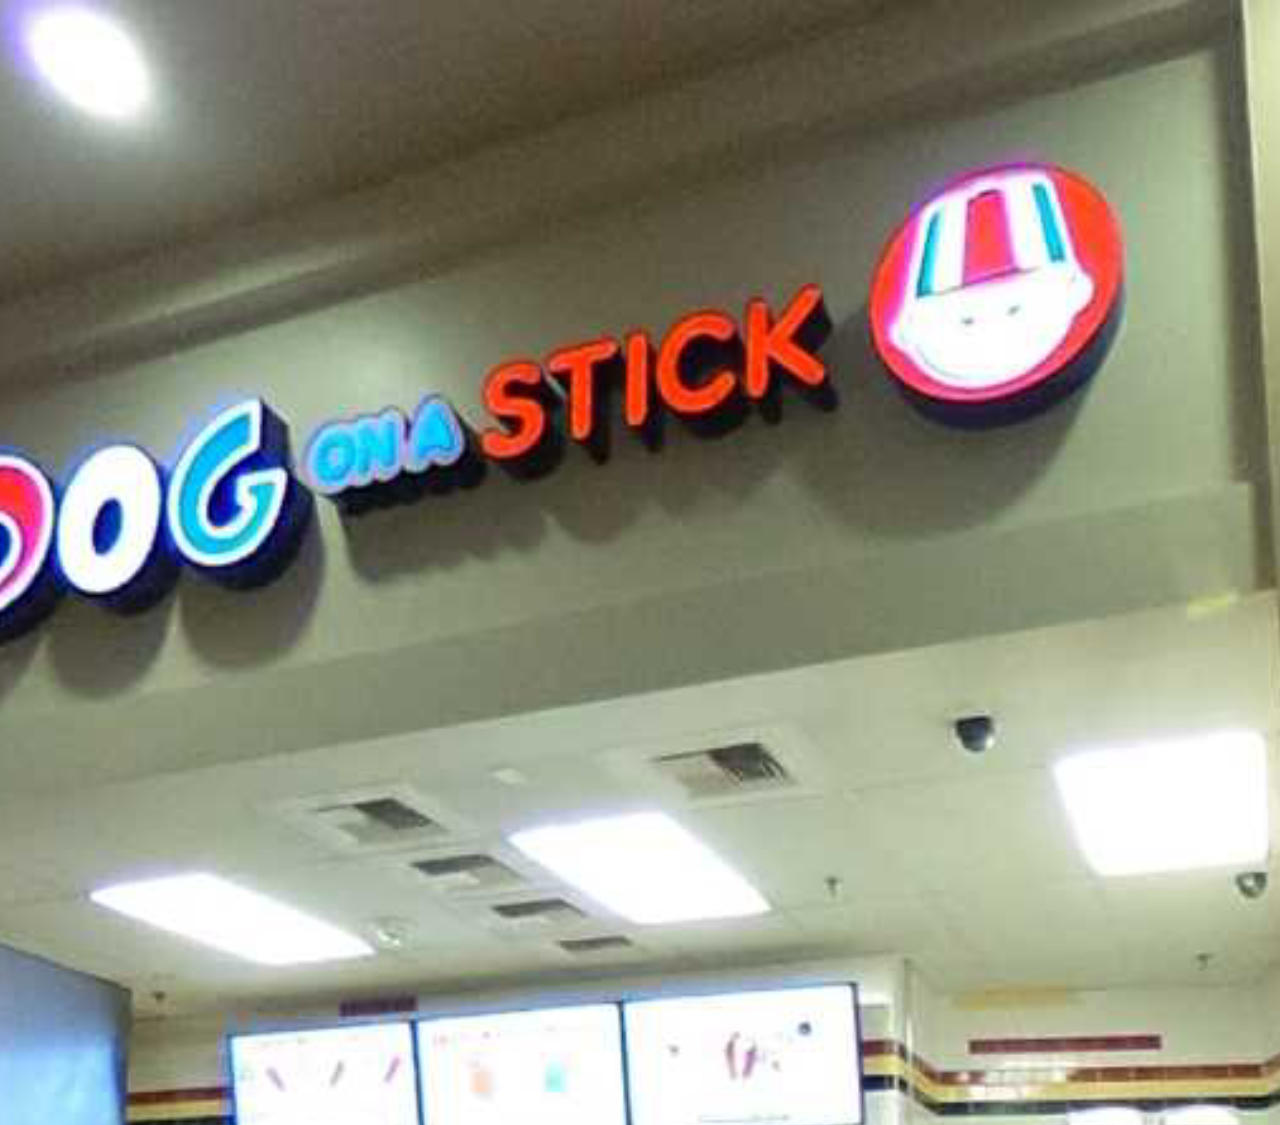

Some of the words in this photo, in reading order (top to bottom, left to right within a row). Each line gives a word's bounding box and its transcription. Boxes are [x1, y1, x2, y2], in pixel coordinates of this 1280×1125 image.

[305, 406, 400, 494] ON
[400, 392, 464, 471] A
[480, 282, 827, 461] STICK
